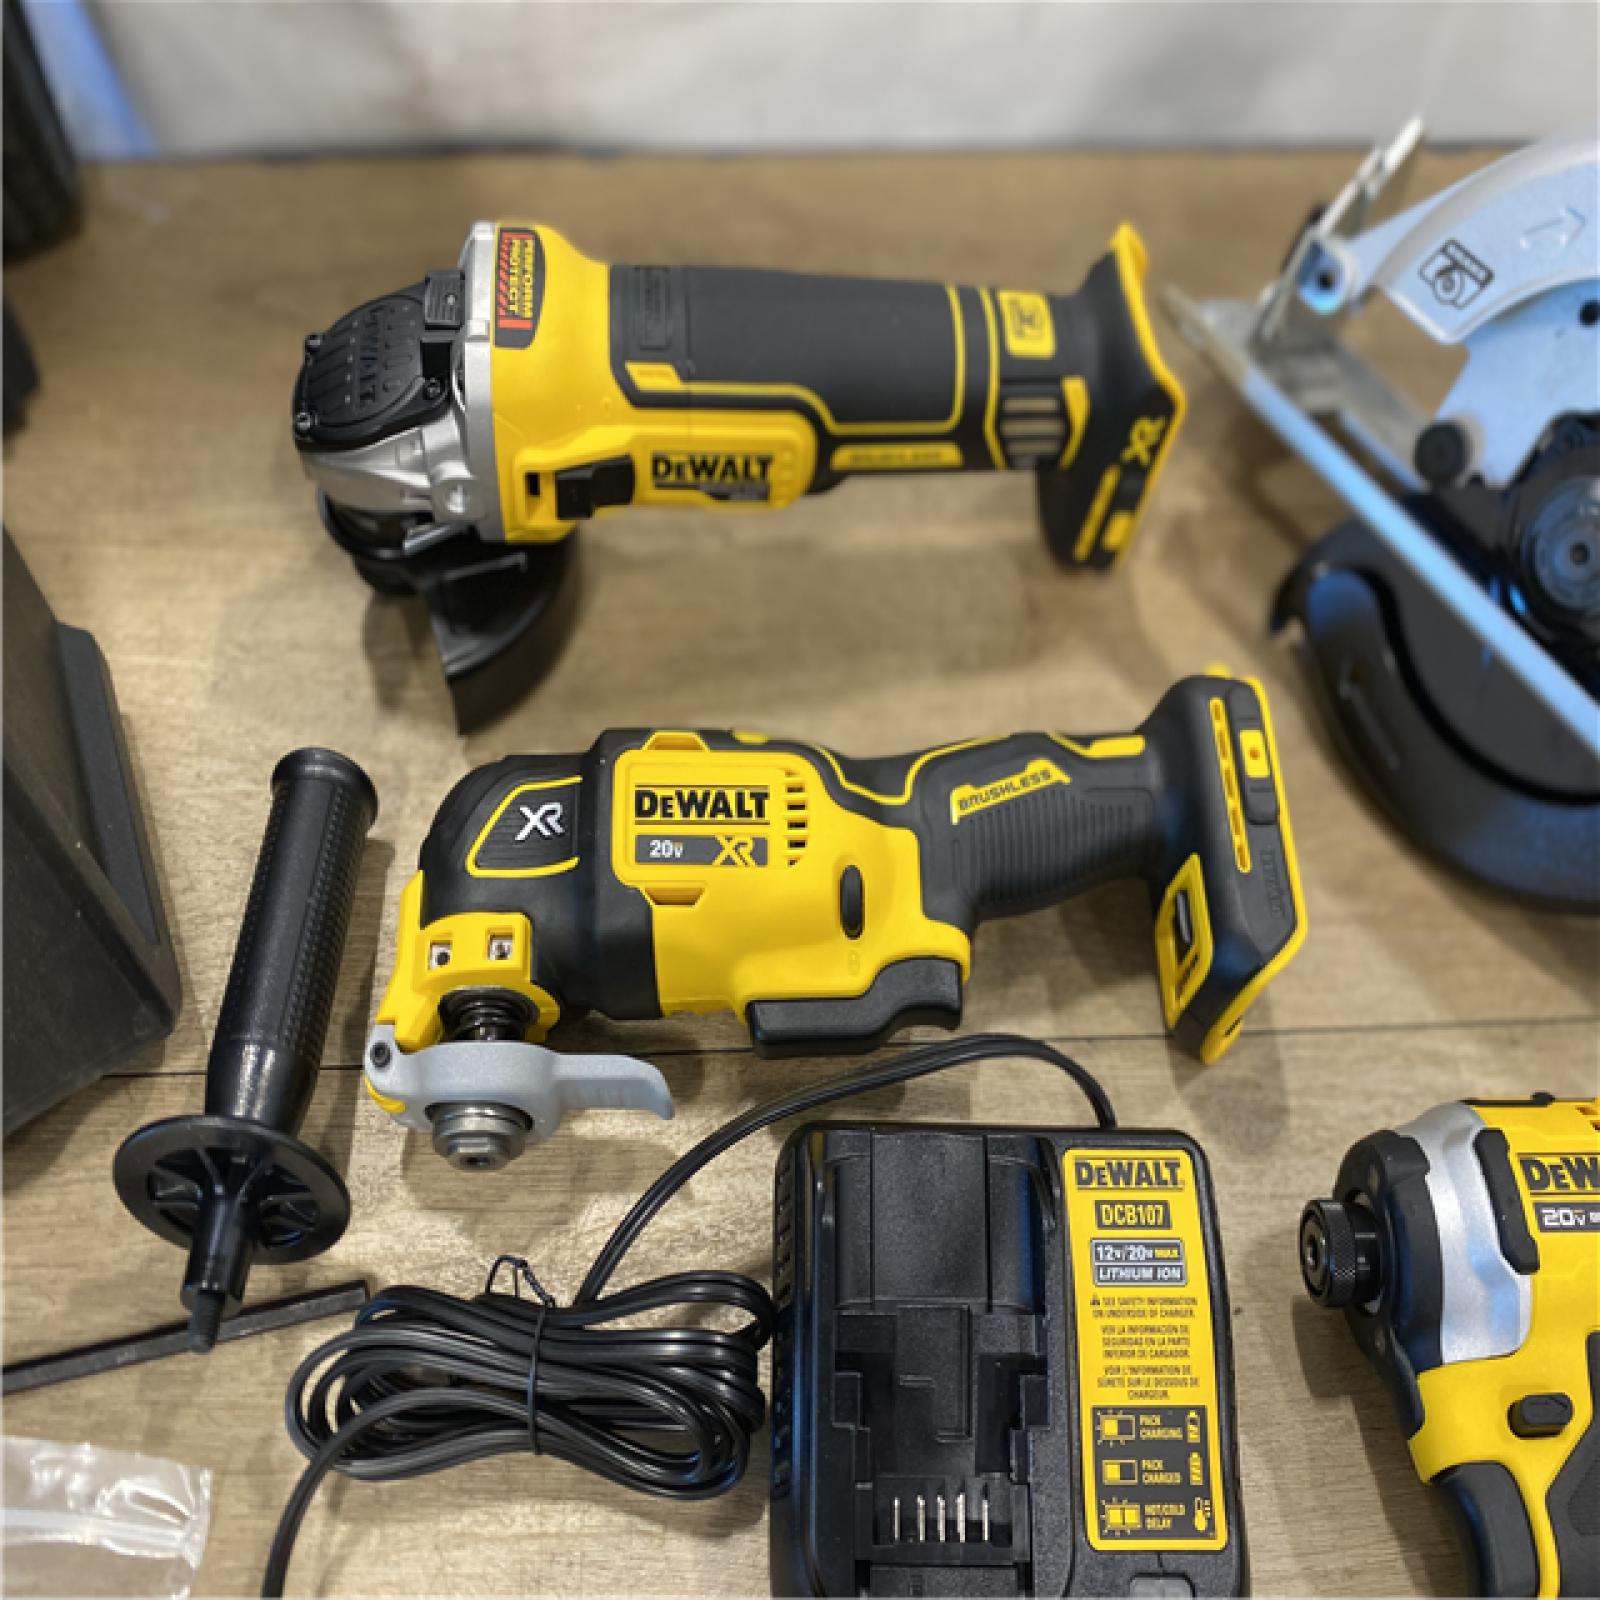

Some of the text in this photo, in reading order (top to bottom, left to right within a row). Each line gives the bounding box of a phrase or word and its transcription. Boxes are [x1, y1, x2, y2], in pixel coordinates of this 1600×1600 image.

[508, 238, 521, 314] PROTECT
[522, 238, 536, 318] PERFORM
[958, 769, 1051, 811] BRUSHLESS
[515, 802, 564, 841] XR
[713, 836, 756, 867] XR
[1076, 1162, 1181, 1186] DEWALT
[1101, 1204, 1164, 1226] DCB107
[1099, 1267, 1181, 1281] LITHIUM ION
